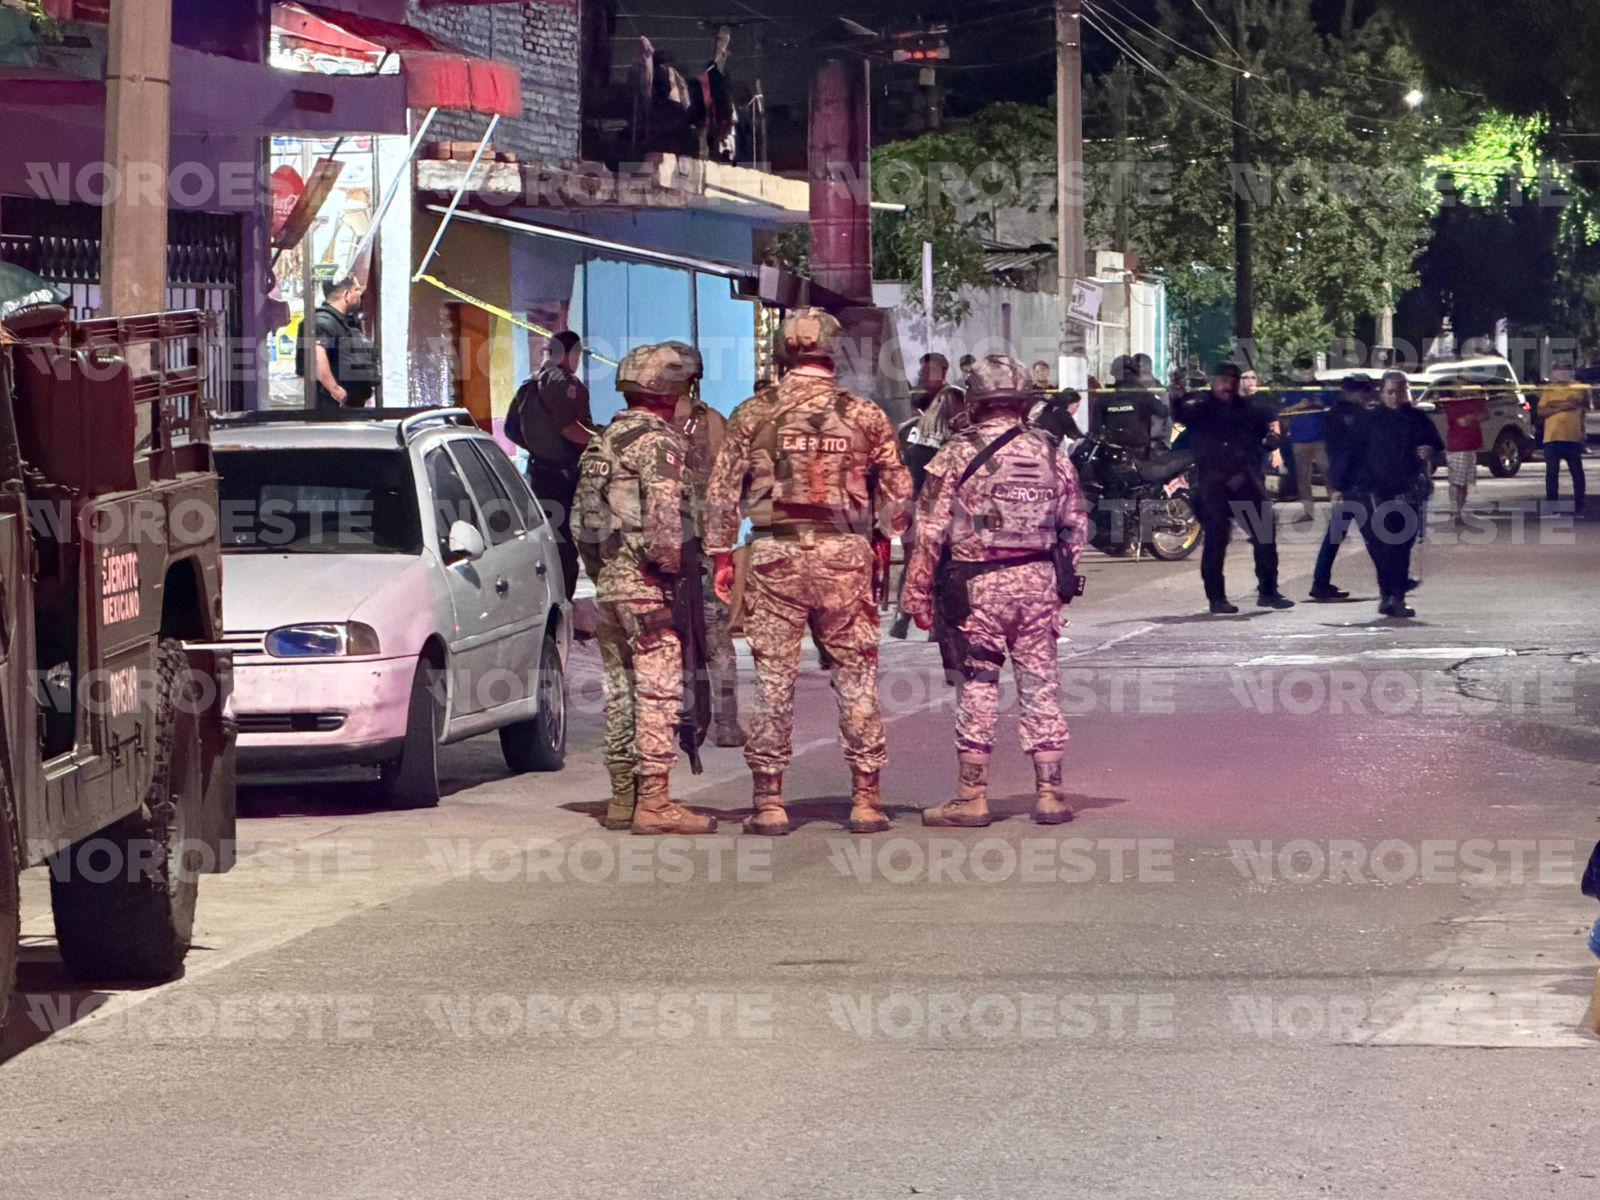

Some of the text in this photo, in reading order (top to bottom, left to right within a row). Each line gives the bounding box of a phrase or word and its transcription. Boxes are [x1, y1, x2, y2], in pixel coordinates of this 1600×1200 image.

[1107, 404, 1134, 413] POLICIA
[994, 485, 1054, 502] EERCITO
[103, 590, 140, 625] MEXICANO
